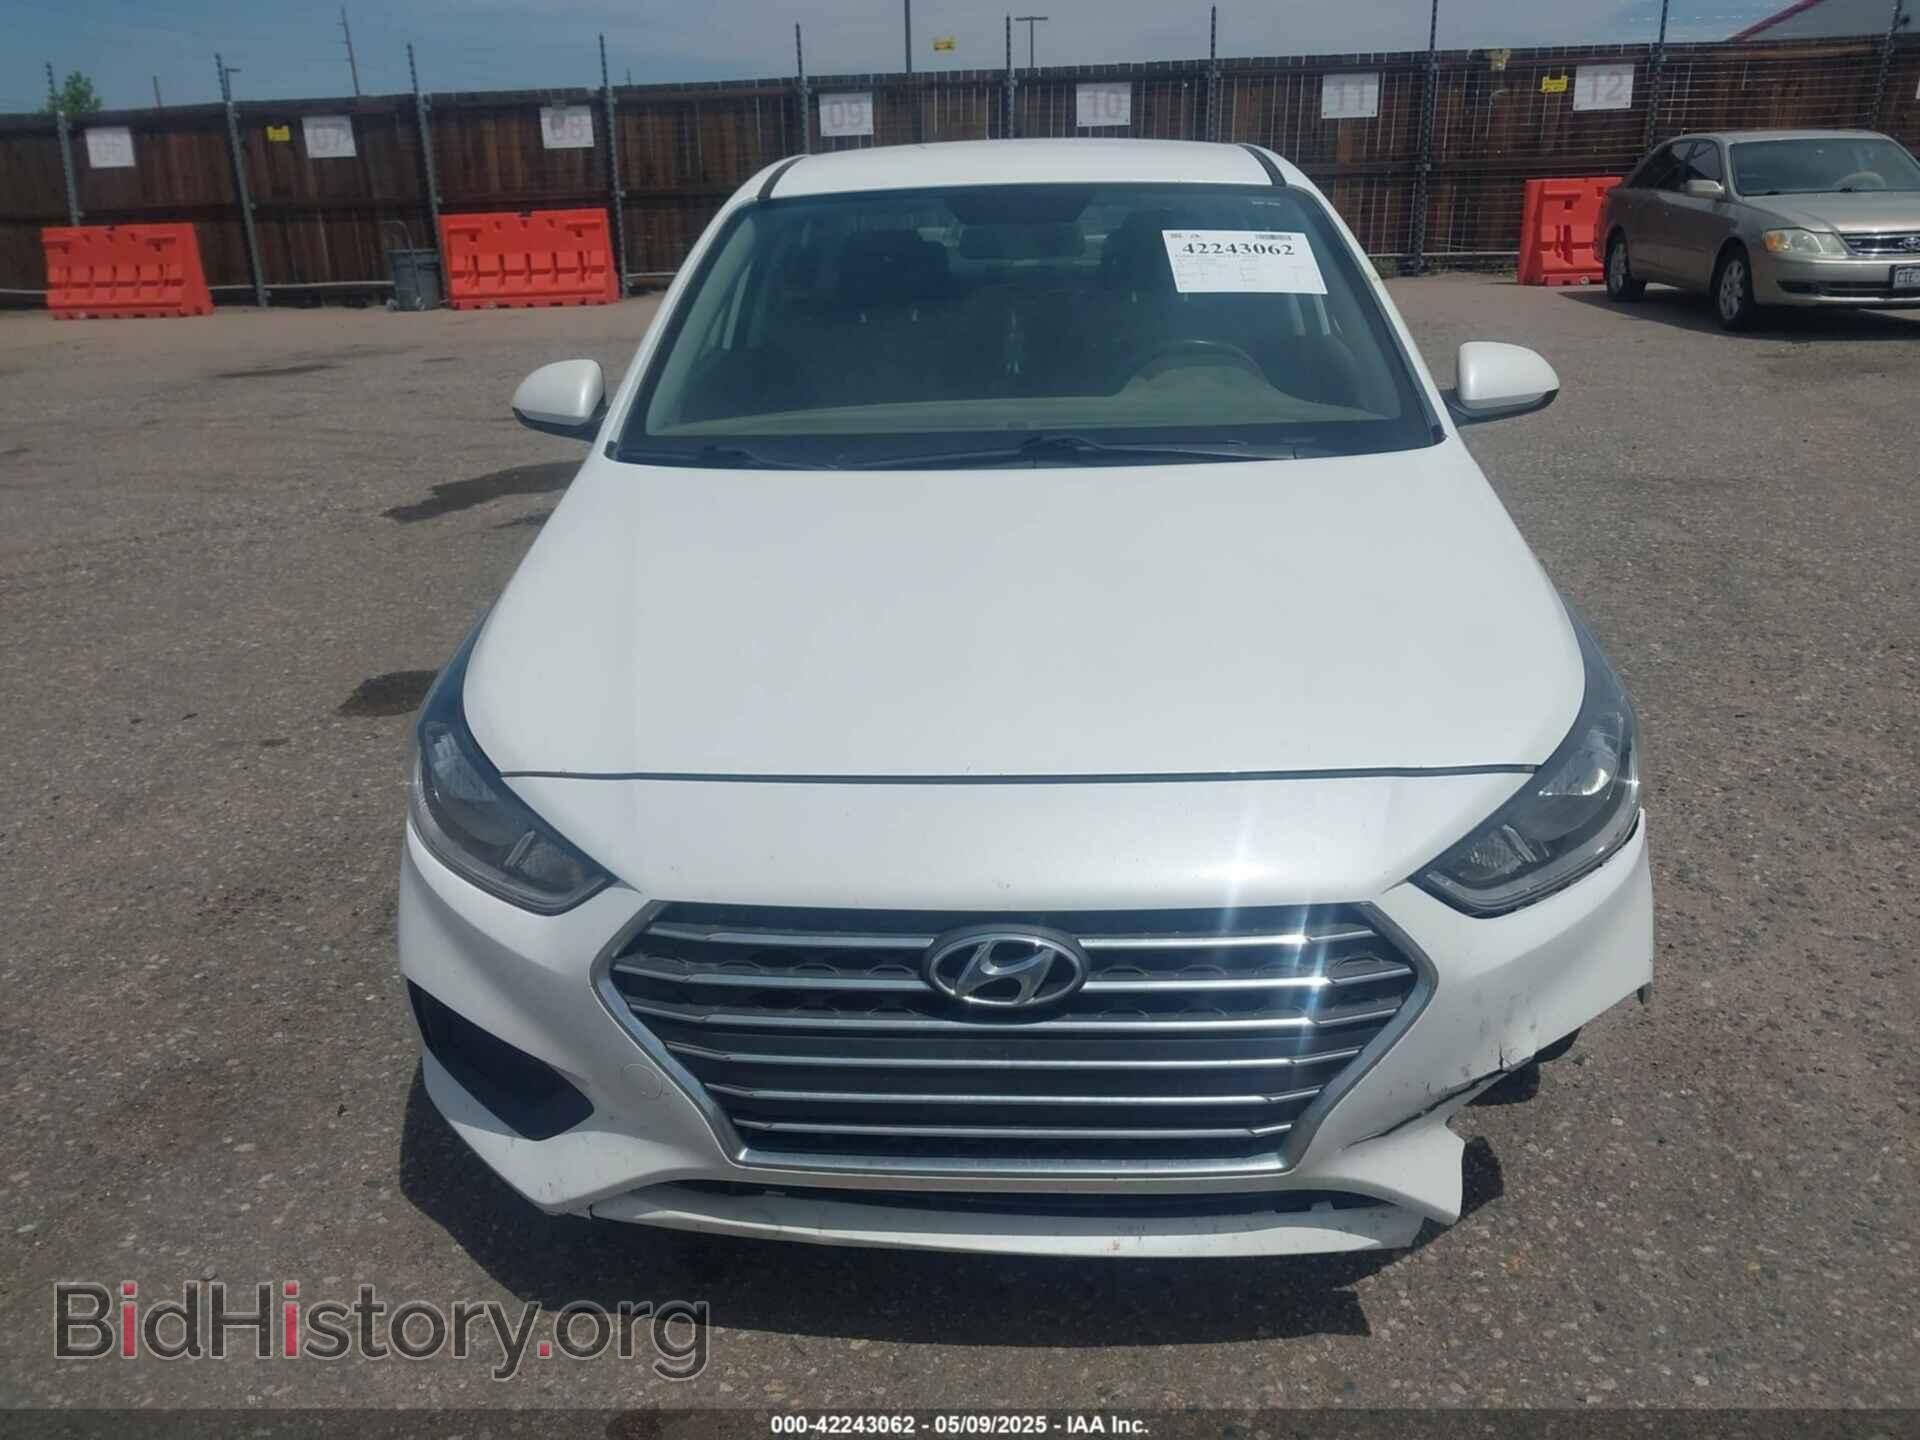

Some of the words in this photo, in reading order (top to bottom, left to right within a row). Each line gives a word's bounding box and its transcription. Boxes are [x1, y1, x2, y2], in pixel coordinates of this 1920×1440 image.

[1333, 80, 1364, 112] 11
[1585, 71, 1624, 102] 12
[830, 101, 864, 129] 09
[1086, 89, 1121, 119] 10
[1182, 242, 1295, 256] 42243062
